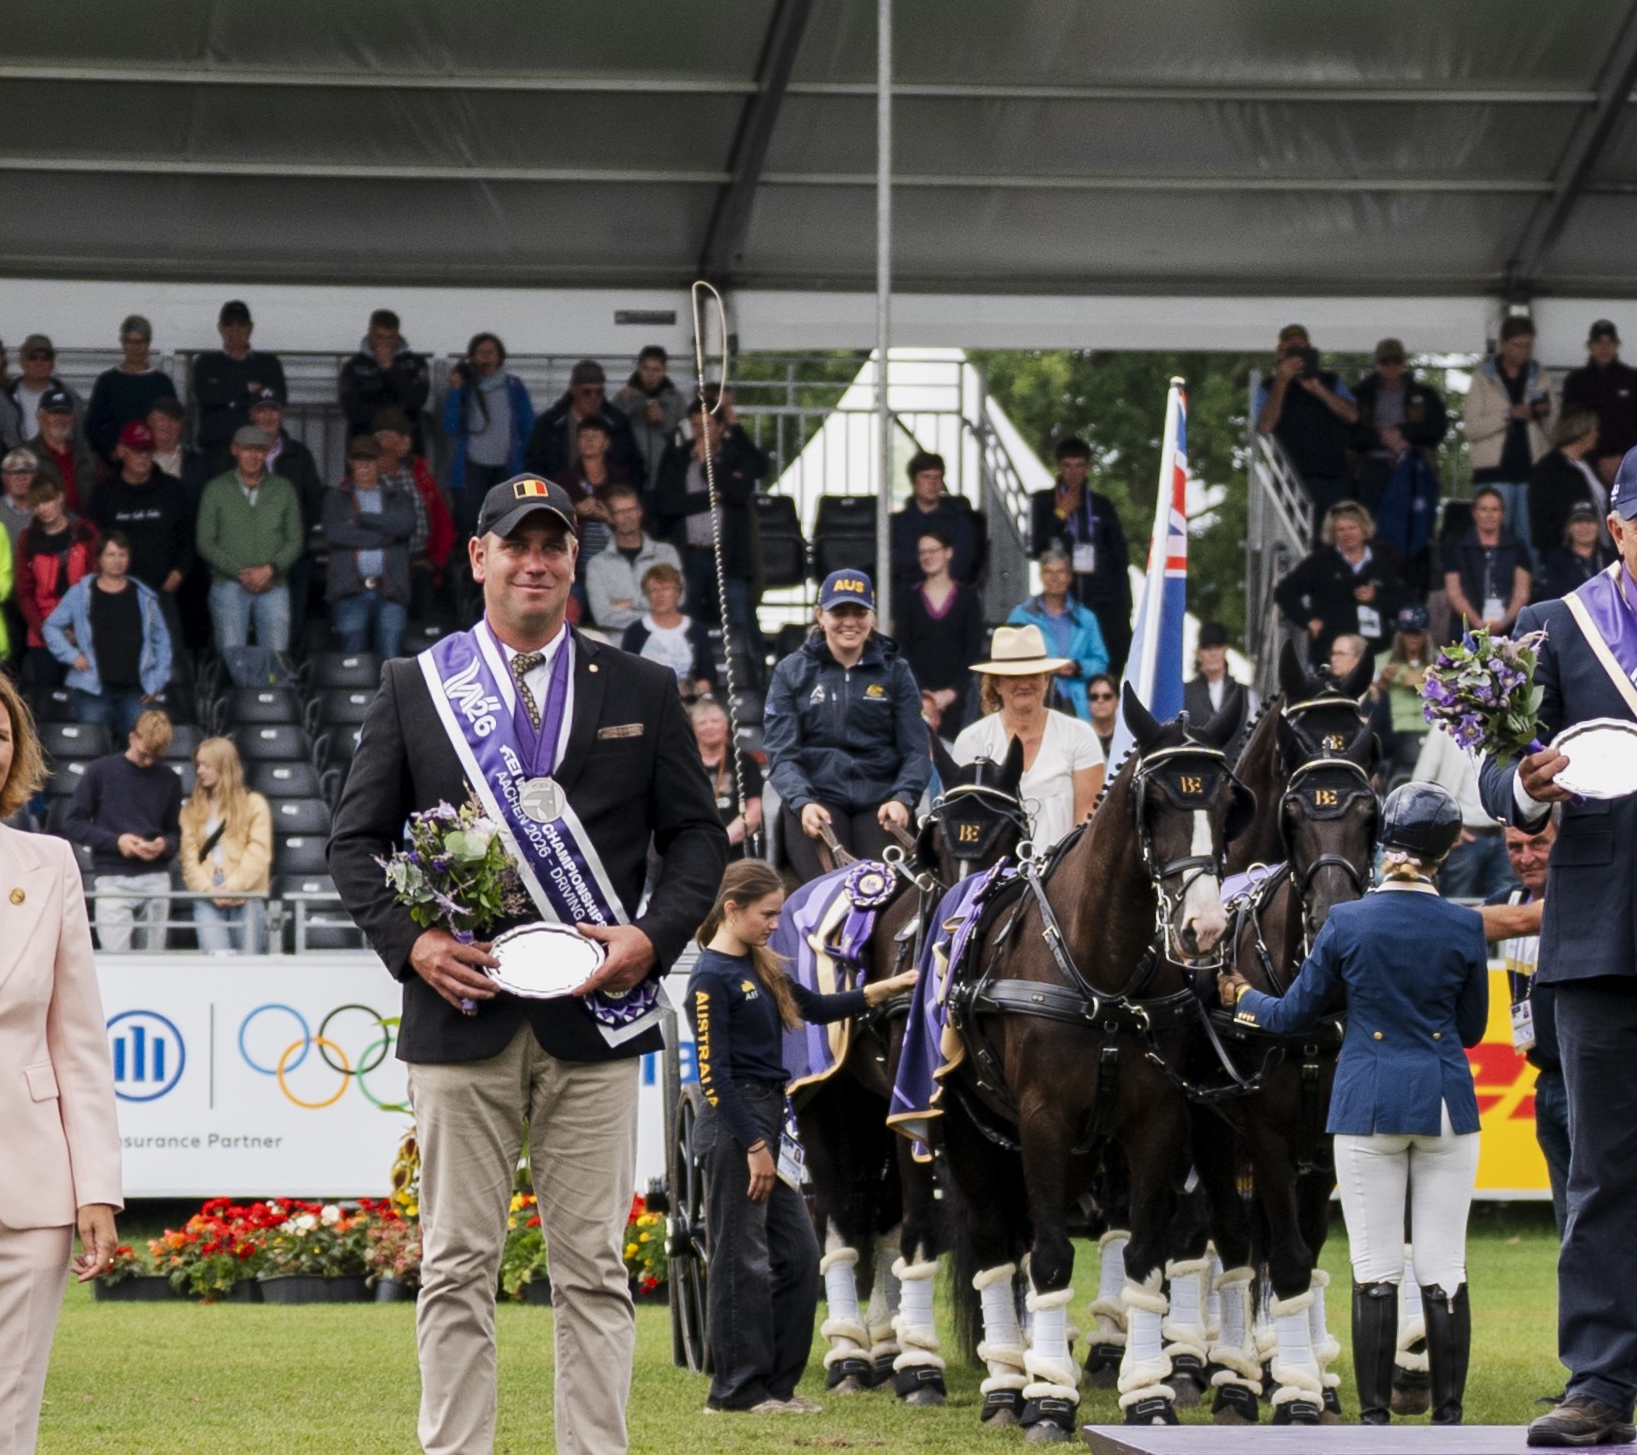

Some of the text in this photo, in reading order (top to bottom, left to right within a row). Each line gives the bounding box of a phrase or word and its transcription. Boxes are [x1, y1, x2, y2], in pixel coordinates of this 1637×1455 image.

[833, 579, 865, 593] AUS
[499, 744, 524, 777] FEI
[1180, 776, 1203, 794] BE
[1315, 789, 1338, 806] BE
[959, 824, 980, 842] BE
[495, 771, 530, 826] AACHEN
[523, 823, 552, 858] 2026
[550, 867, 586, 921] DRIVING
[541, 823, 608, 927] CHAMPIONSHIPS
[695, 990, 719, 1108] AUSTRALIA
[119, 1133, 284, 1150] surance Partner
